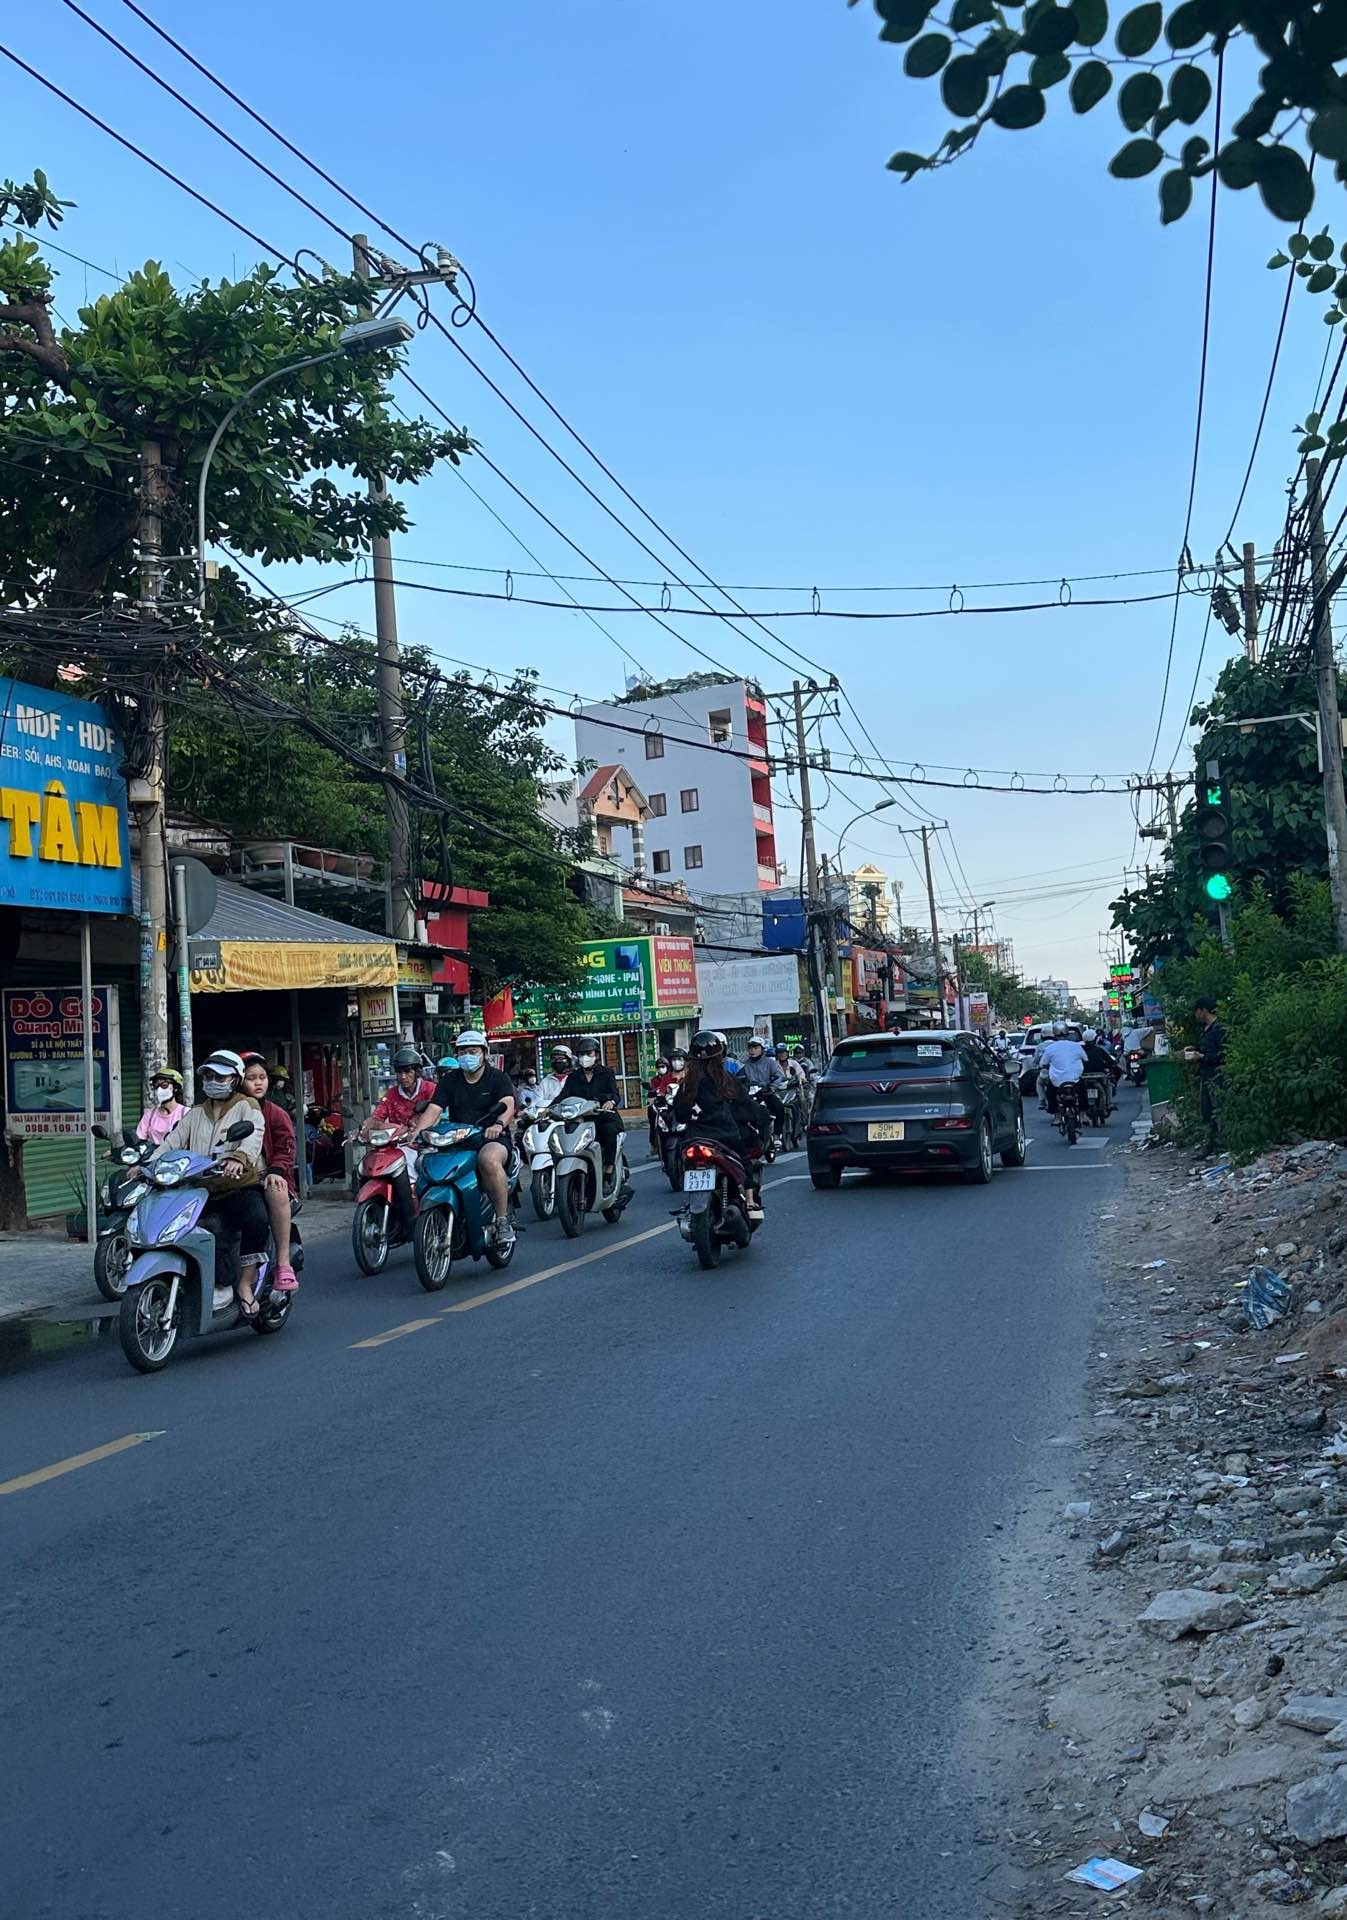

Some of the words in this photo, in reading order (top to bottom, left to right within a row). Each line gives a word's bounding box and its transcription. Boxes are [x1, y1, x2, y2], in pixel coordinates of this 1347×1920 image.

[16, 703, 62, 740] MDF
[79, 720, 116, 754] HDF
[67, 758, 90, 776] XOAN
[0, 779, 122, 869] TÂM
[367, 998, 387, 1016] MINH
[13, 1019, 61, 1038] Quang
[688, 1180, 710, 1190] 2371
